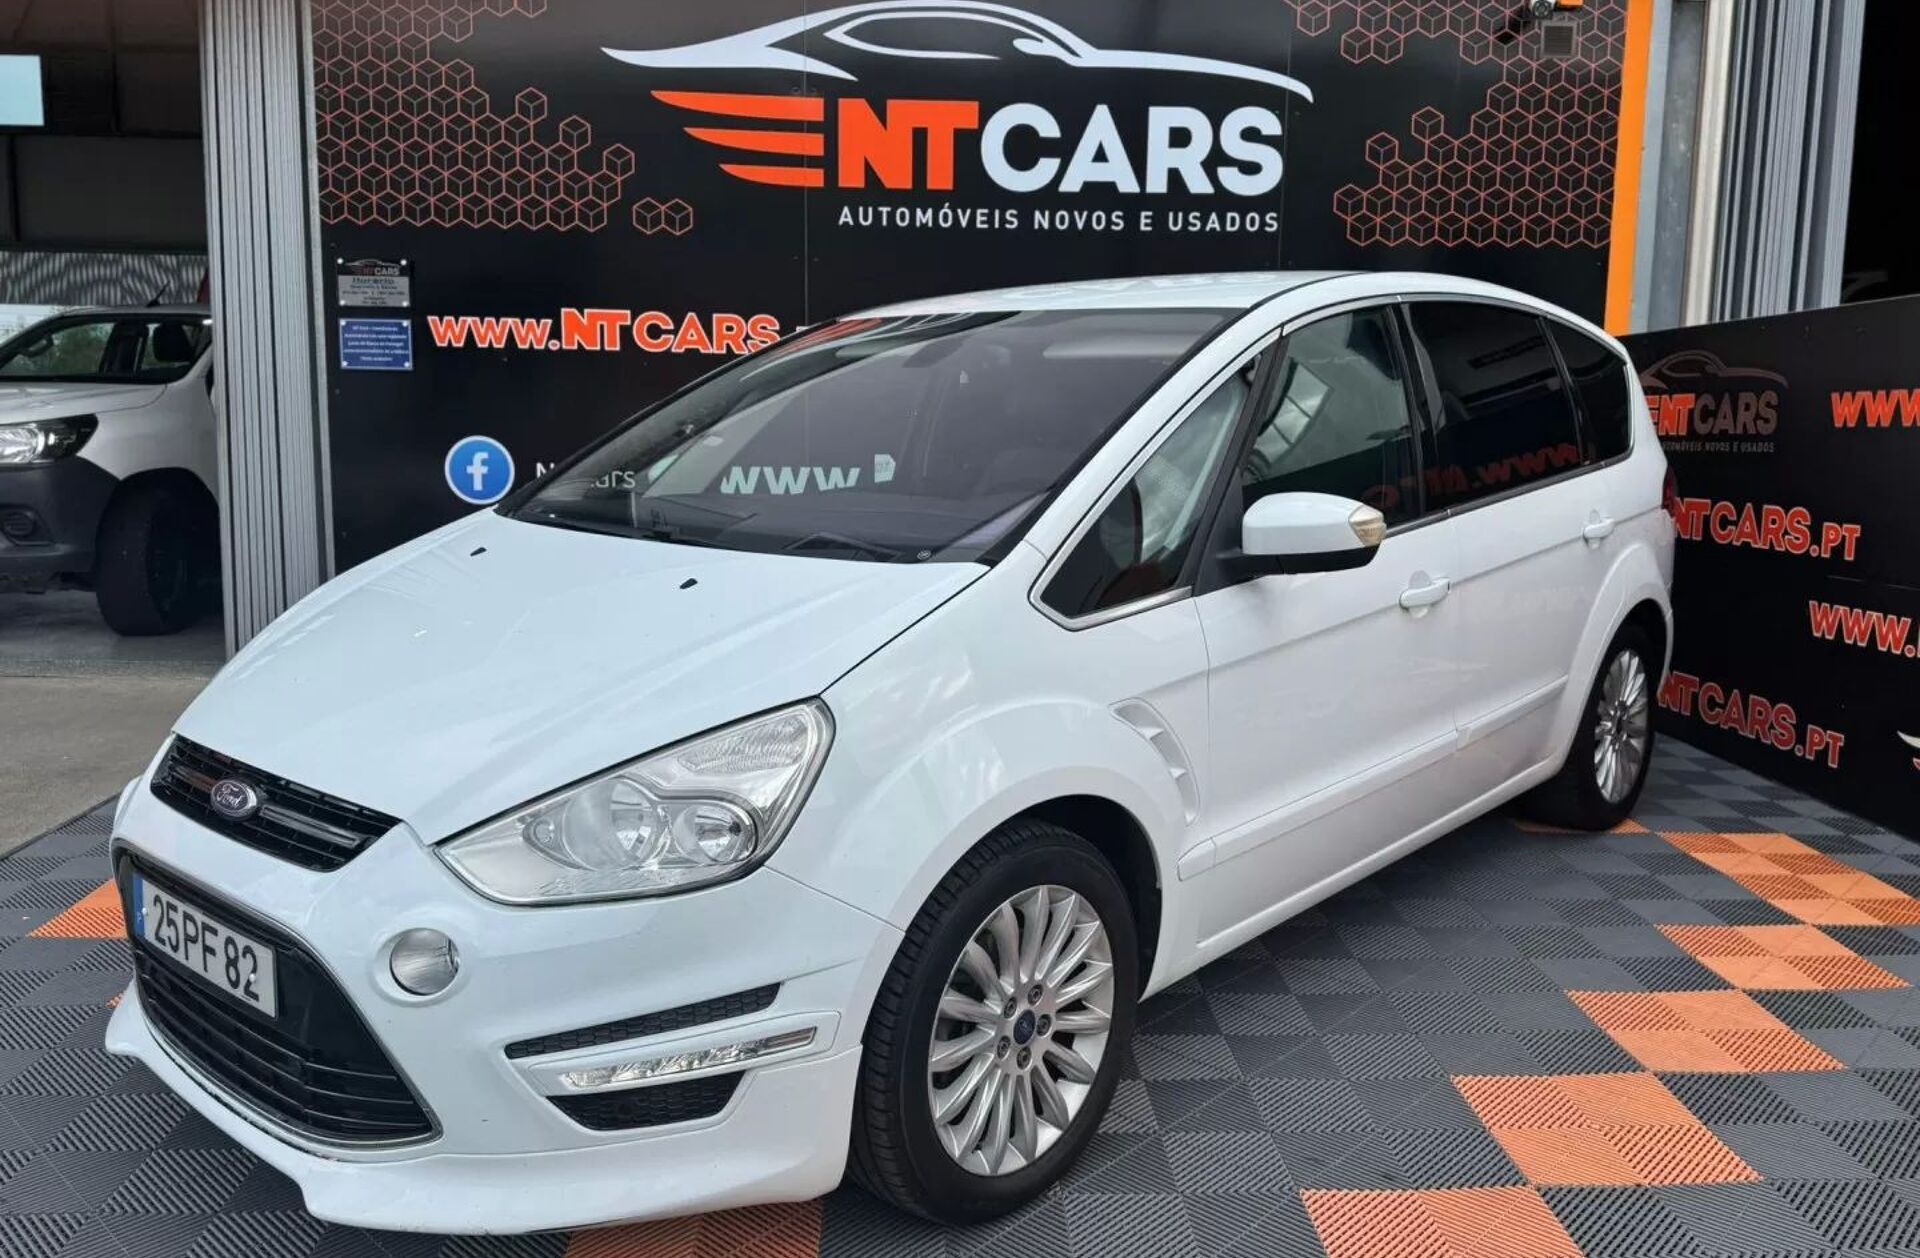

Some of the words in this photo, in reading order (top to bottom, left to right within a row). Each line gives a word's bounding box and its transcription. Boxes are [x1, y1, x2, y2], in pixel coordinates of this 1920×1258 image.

[838, 203, 1020, 230] AUTOMÓVEIS
[1034, 211, 1125, 231] NOVOS
[1140, 212, 1153, 231] E
[1168, 213, 1279, 233] USADOS
[427, 308, 808, 354] www.NTCARS
[1809, 600, 1920, 659] www.
